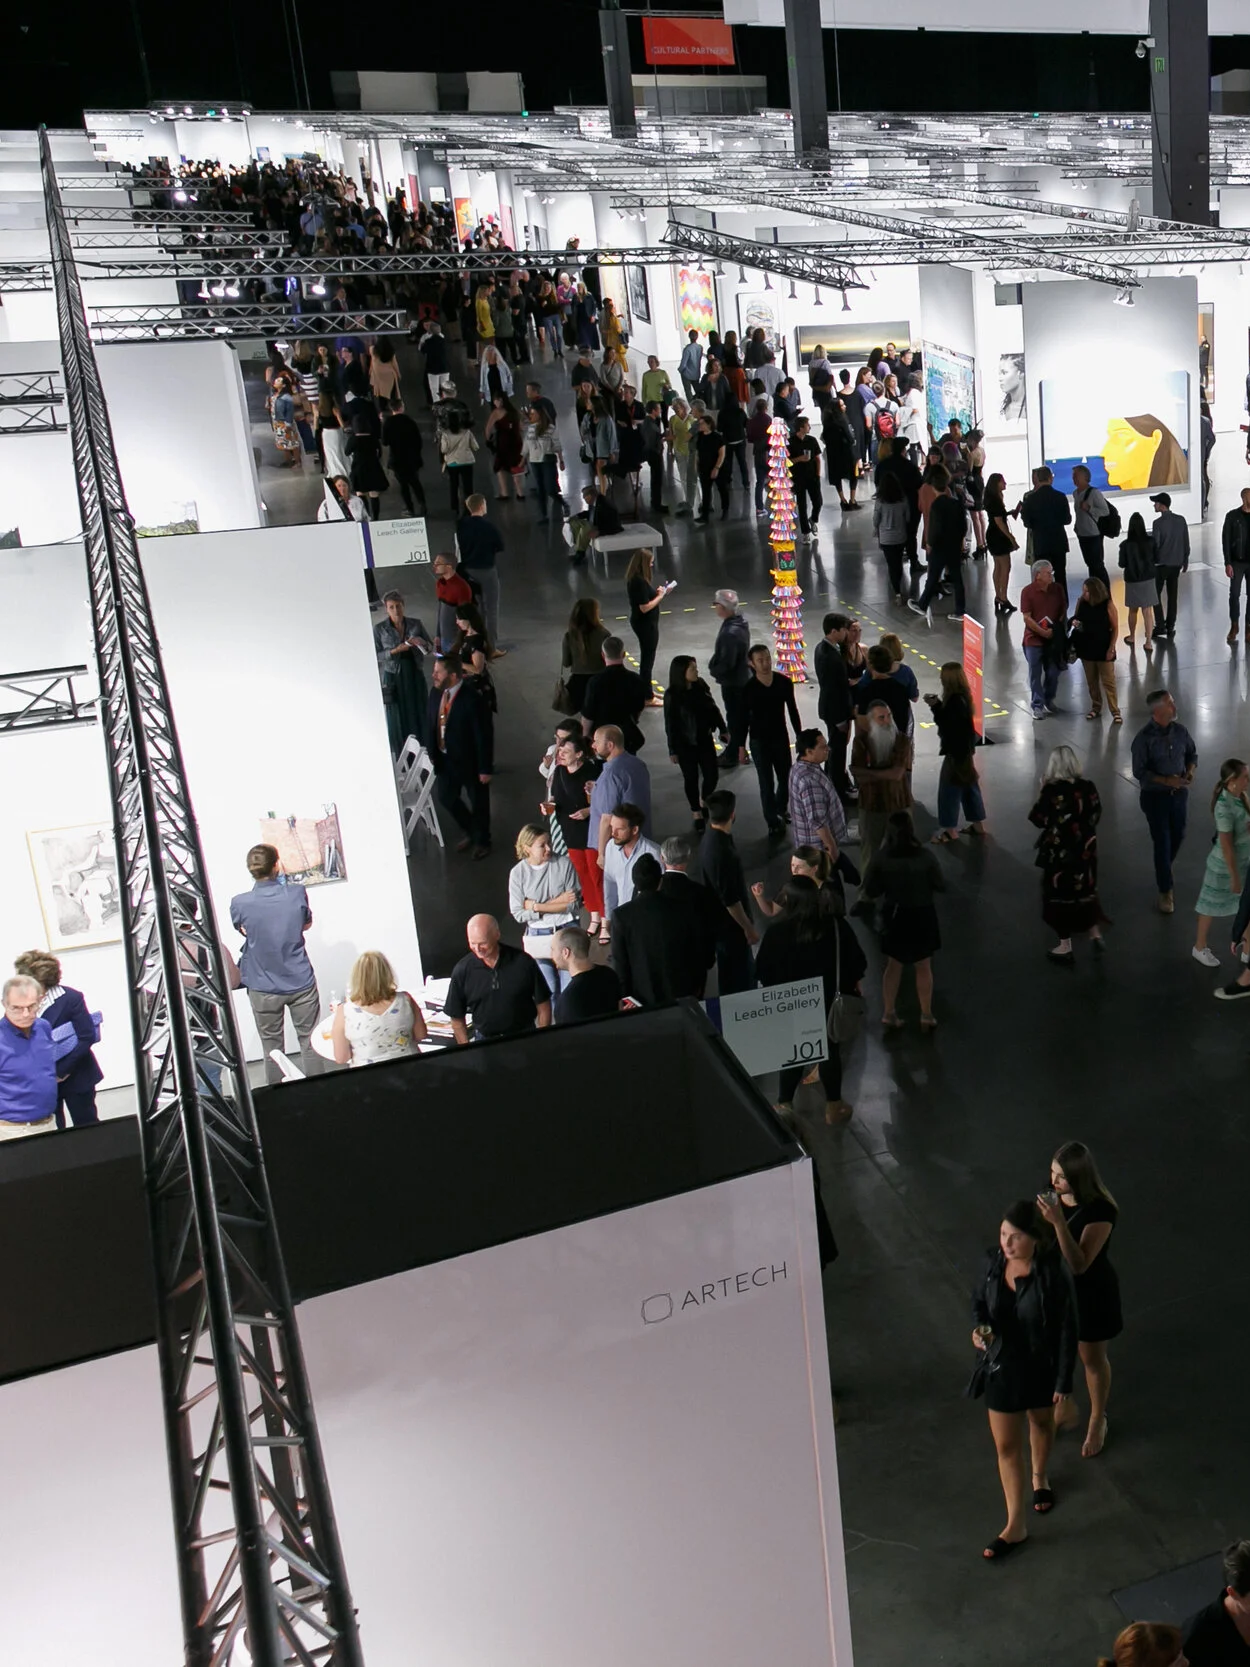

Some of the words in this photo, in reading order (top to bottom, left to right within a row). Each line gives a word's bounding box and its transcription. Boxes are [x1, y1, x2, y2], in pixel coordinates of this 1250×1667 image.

[653, 47, 689, 55] CULTURAL
[762, 983, 819, 1002] Elizabeth
[735, 1005, 772, 1021] Leach
[776, 997, 820, 1013] Gallery
[681, 1261, 787, 1310] ARTECH
